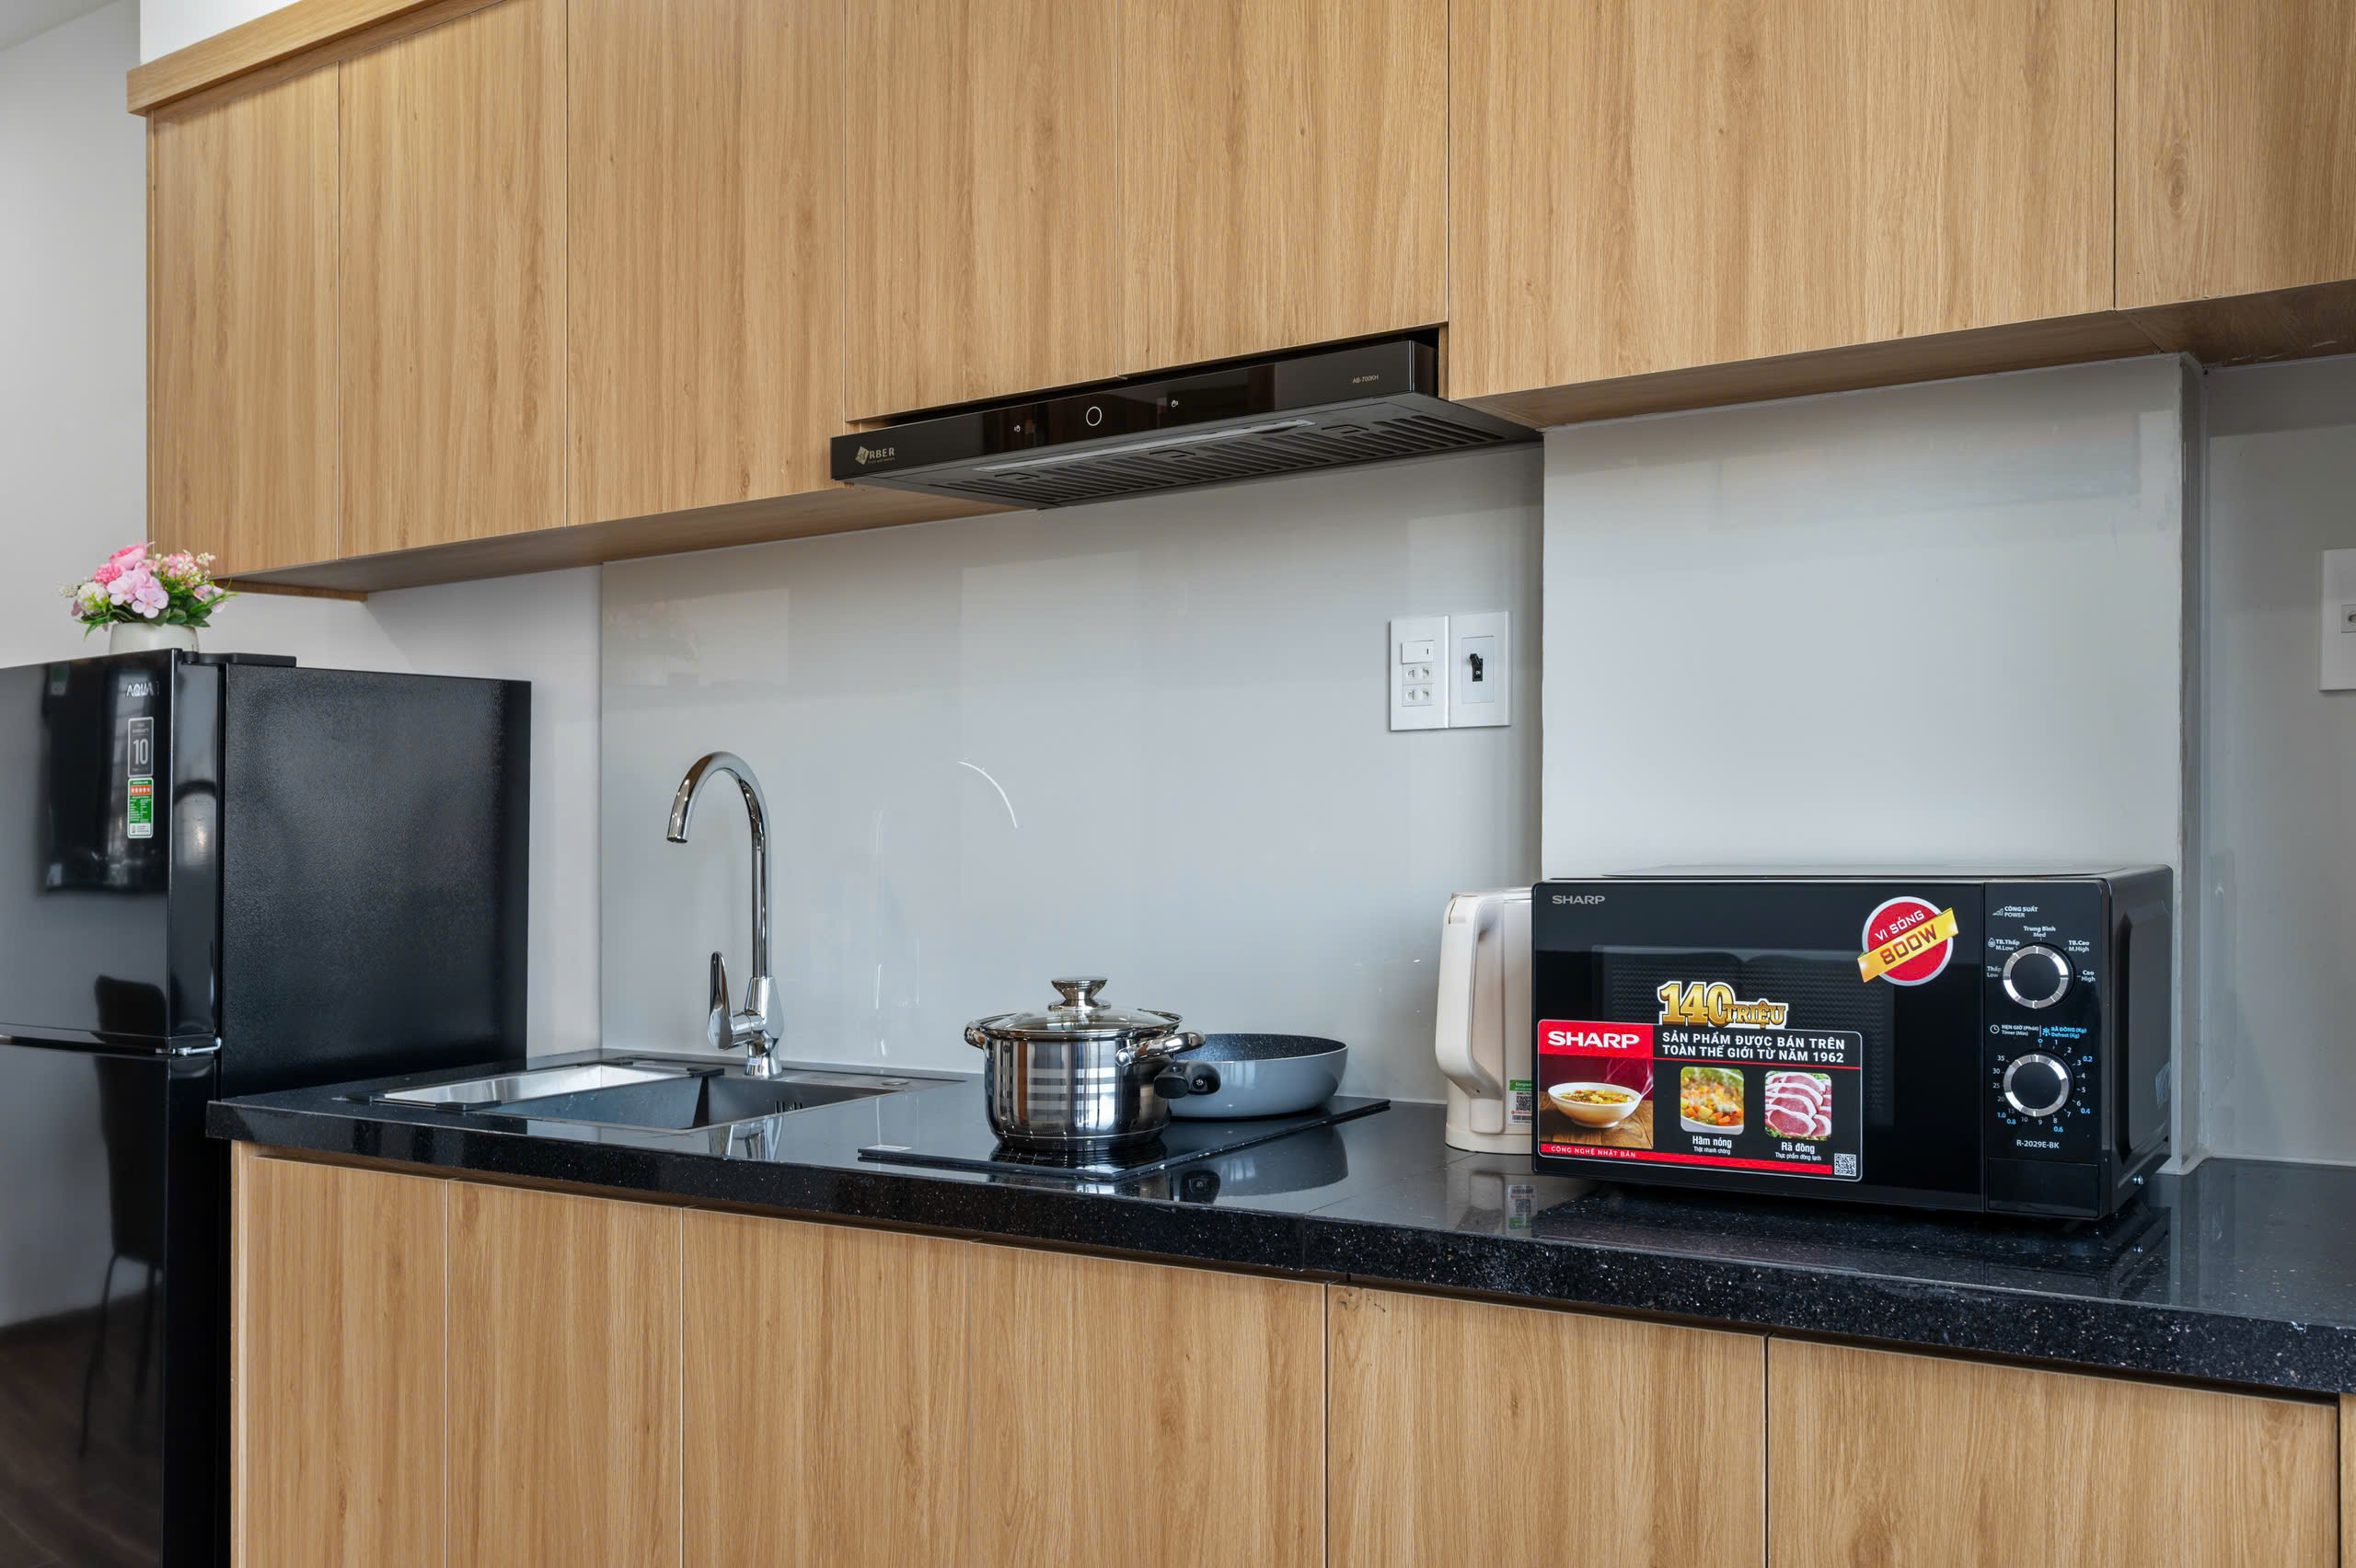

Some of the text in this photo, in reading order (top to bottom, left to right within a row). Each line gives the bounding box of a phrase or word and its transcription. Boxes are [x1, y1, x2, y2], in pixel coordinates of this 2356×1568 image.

[126, 682, 154, 697] AQUA
[133, 738, 148, 765] 10
[1552, 894, 1606, 905] SHARP
[1875, 909, 1925, 940] VI SÓNG
[1879, 923, 1937, 965] 800W
[1659, 983, 1734, 1027] 140
[1547, 1031, 1640, 1049] SHARP
[1662, 1030, 1845, 1050] SẢN PHẨM ĐƯỢC BÁN TRÊN
[1662, 1043, 1844, 1063] TOÀN THẾ GIỚI TỪ NĂM 1962
[1692, 1135, 1732, 1149] Hâm nóng
[1781, 1141, 1815, 1155] Rã đông
[2016, 1139, 2060, 1148] R-2029E-BK
[1574, 1147, 1595, 1156] NGHỆ
